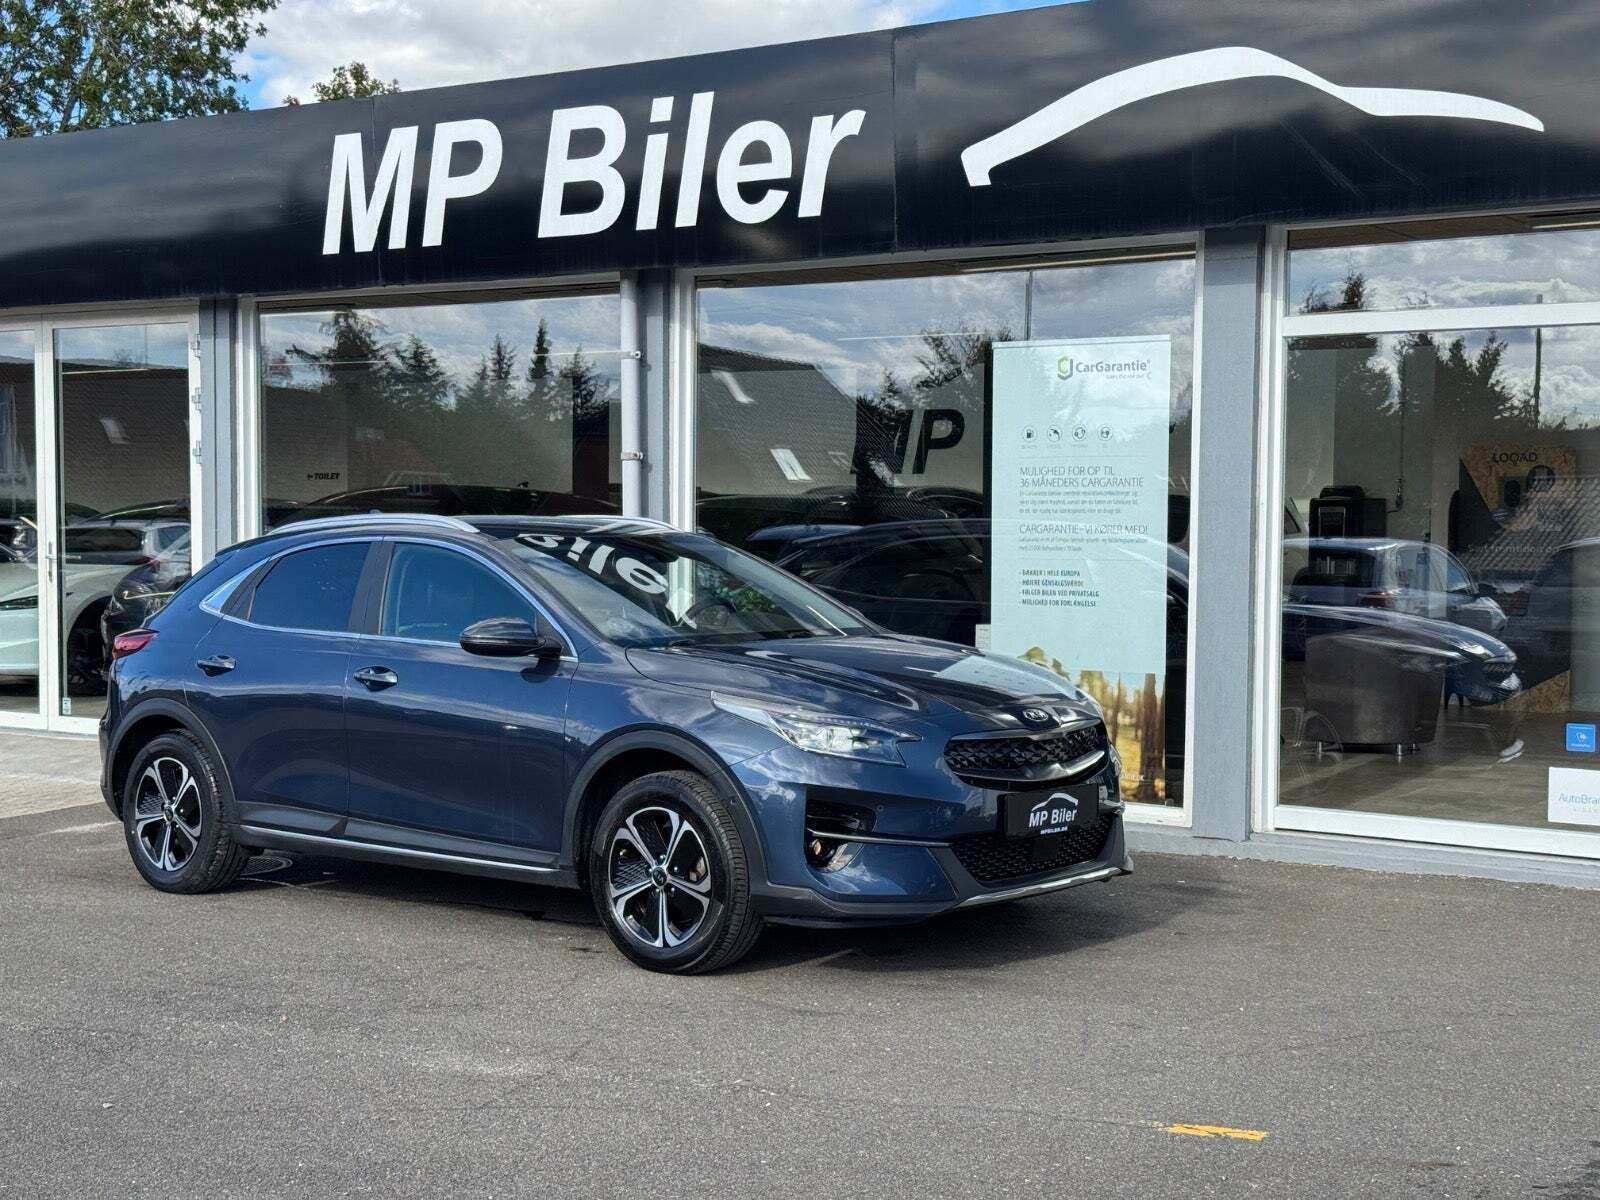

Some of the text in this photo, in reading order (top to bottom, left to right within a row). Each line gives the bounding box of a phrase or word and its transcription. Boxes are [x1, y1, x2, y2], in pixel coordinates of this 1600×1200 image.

[322, 91, 867, 256] MP Biler
[1076, 360, 1147, 373] CarGarantie
[314, 472, 340, 480] TOILET
[1020, 465, 1115, 477] MULIGHED FOR OP TIL
[1020, 476, 1144, 487] 36 MÅNEDERS CARGARANTIE
[1125, 524, 1148, 534] MED!
[1029, 808, 1077, 827] MP Biler
